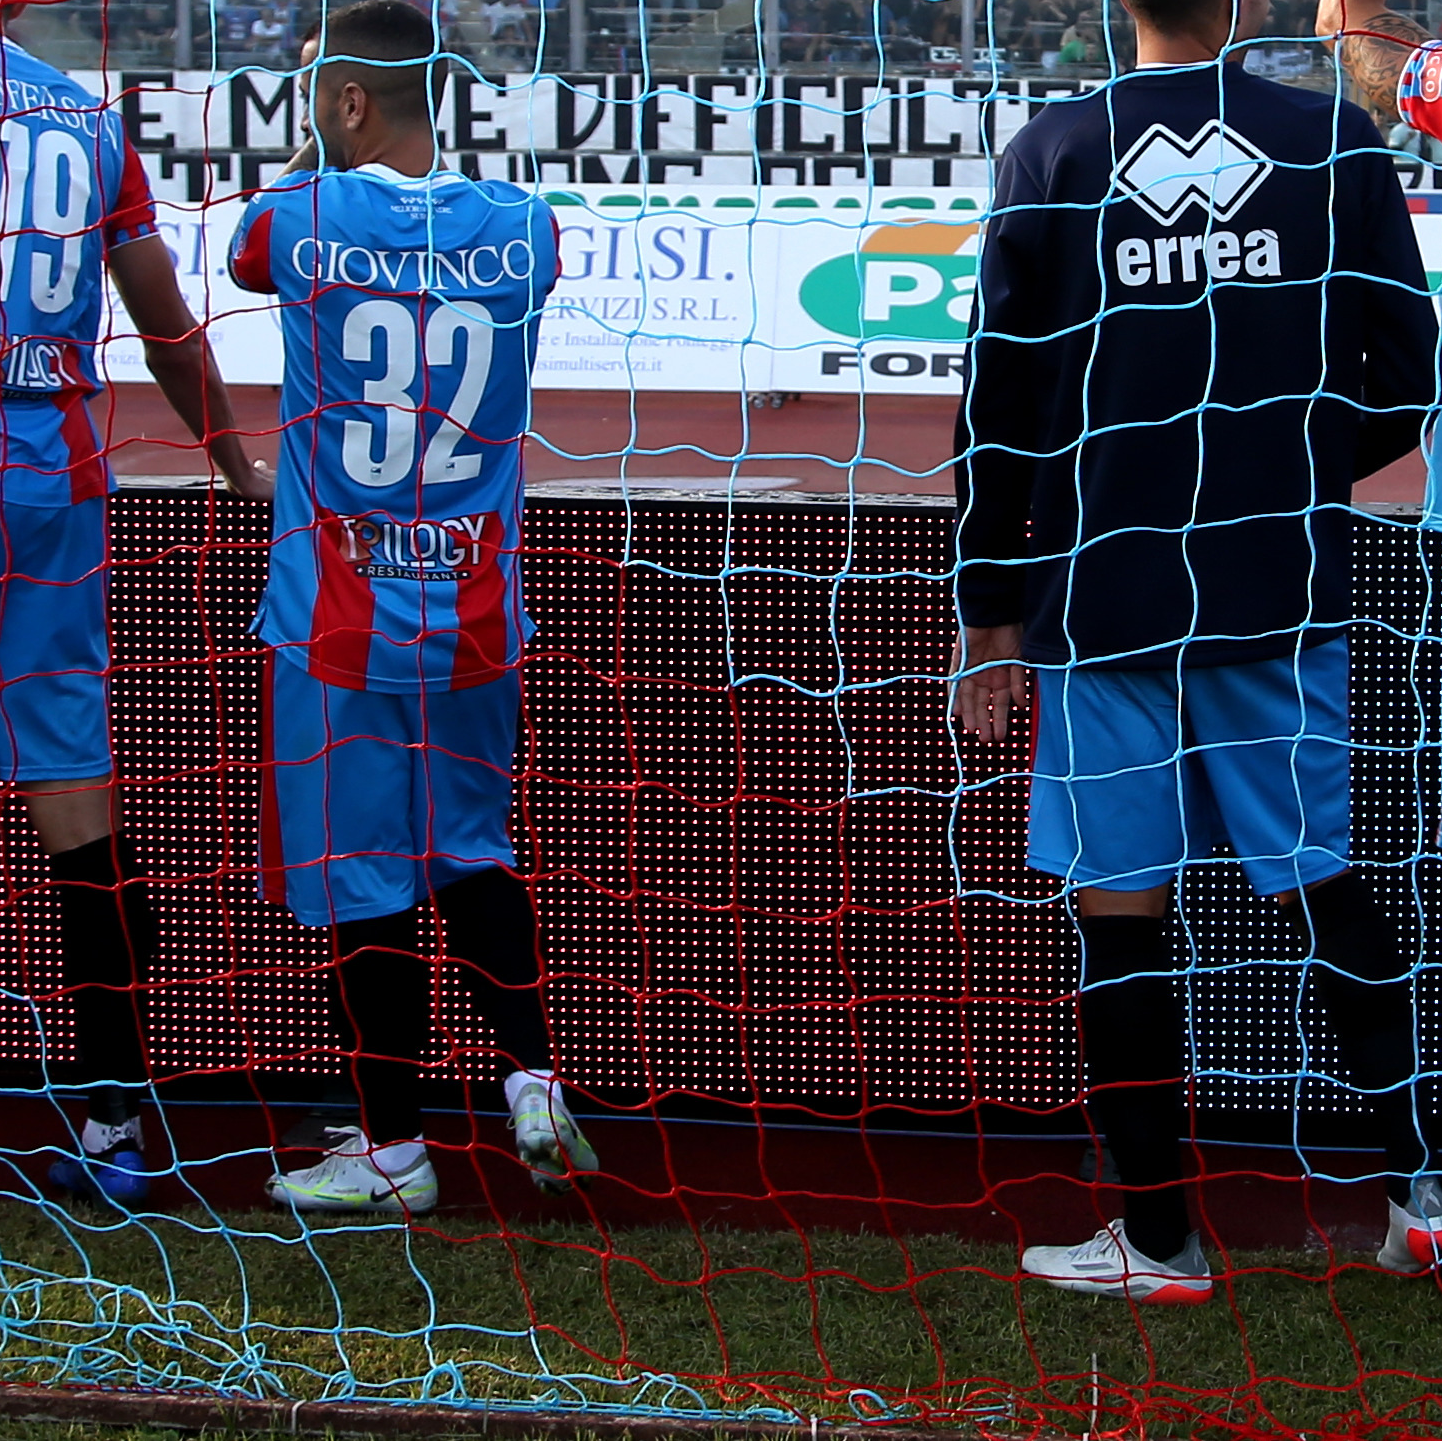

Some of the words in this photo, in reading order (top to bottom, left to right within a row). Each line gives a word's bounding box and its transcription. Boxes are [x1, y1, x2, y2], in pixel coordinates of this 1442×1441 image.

[557, 72, 1071, 155] DIFFICOLT
[290, 236, 539, 293] GIOVINCO
[339, 298, 496, 489] 32
[337, 514, 487, 568] TRILOGY
[367, 565, 458, 581] RESTAURANT
